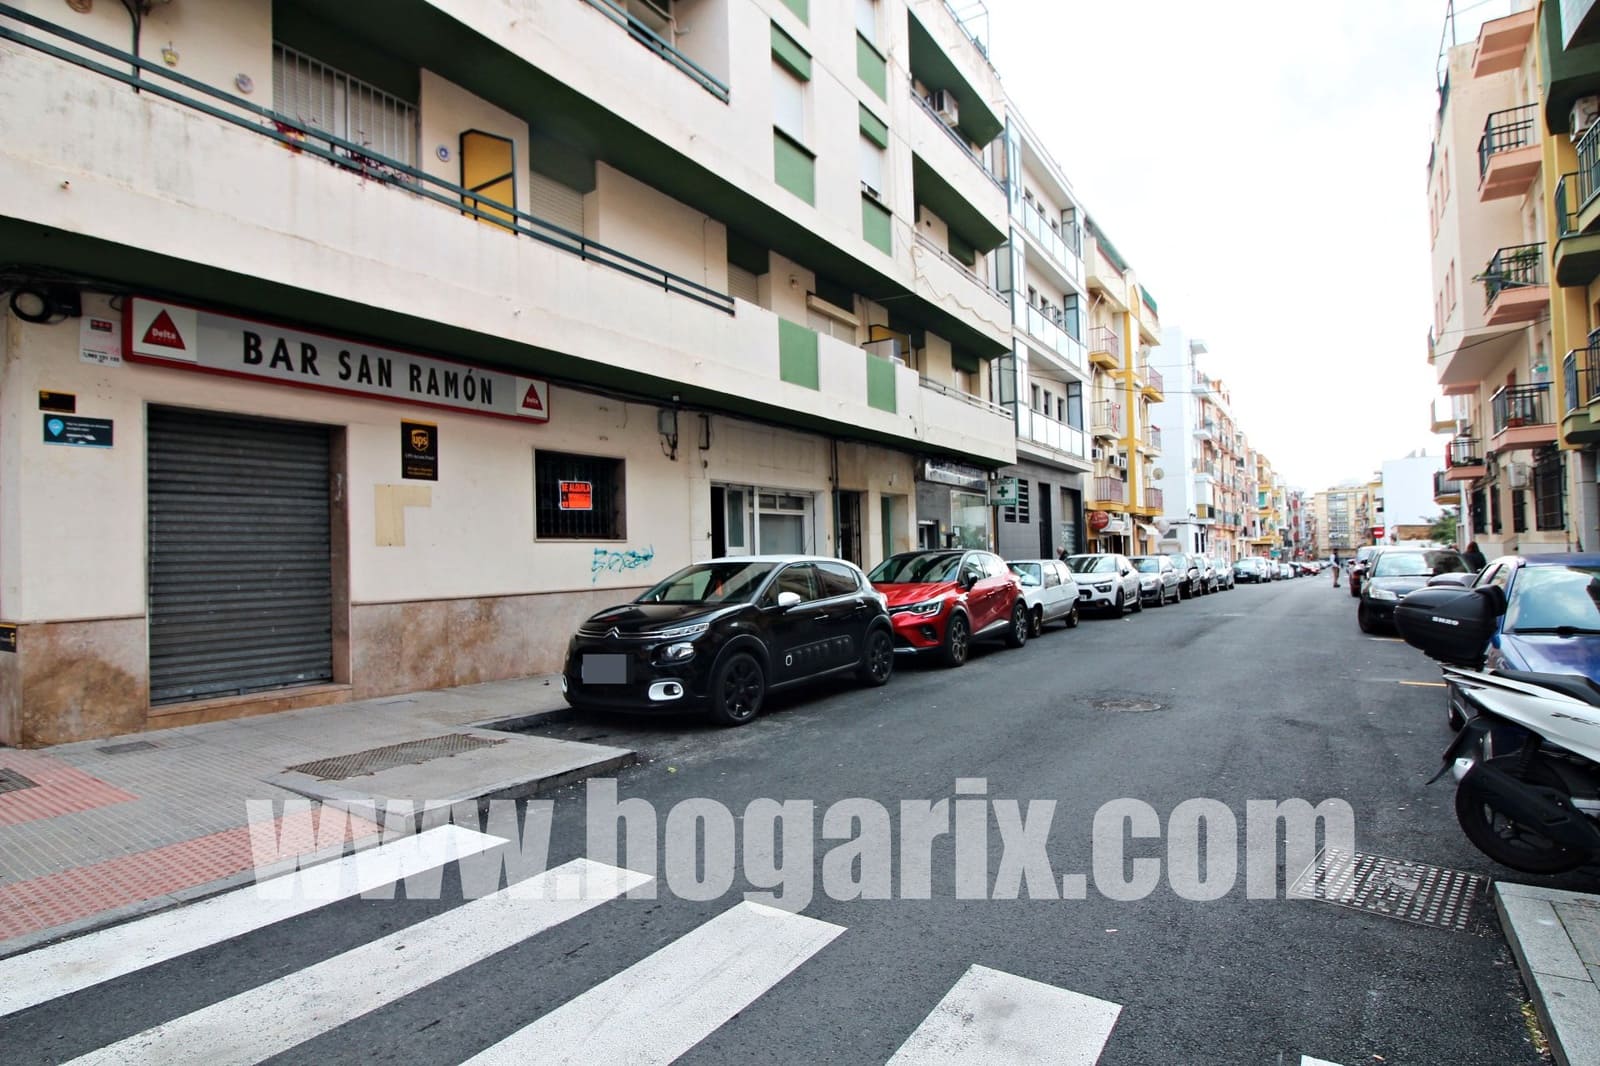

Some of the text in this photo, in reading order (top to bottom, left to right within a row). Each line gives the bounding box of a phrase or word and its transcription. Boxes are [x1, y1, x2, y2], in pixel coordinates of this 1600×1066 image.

[151, 327, 177, 340] Delta
[243, 330, 492, 405] BAR SAN RAMÓN
